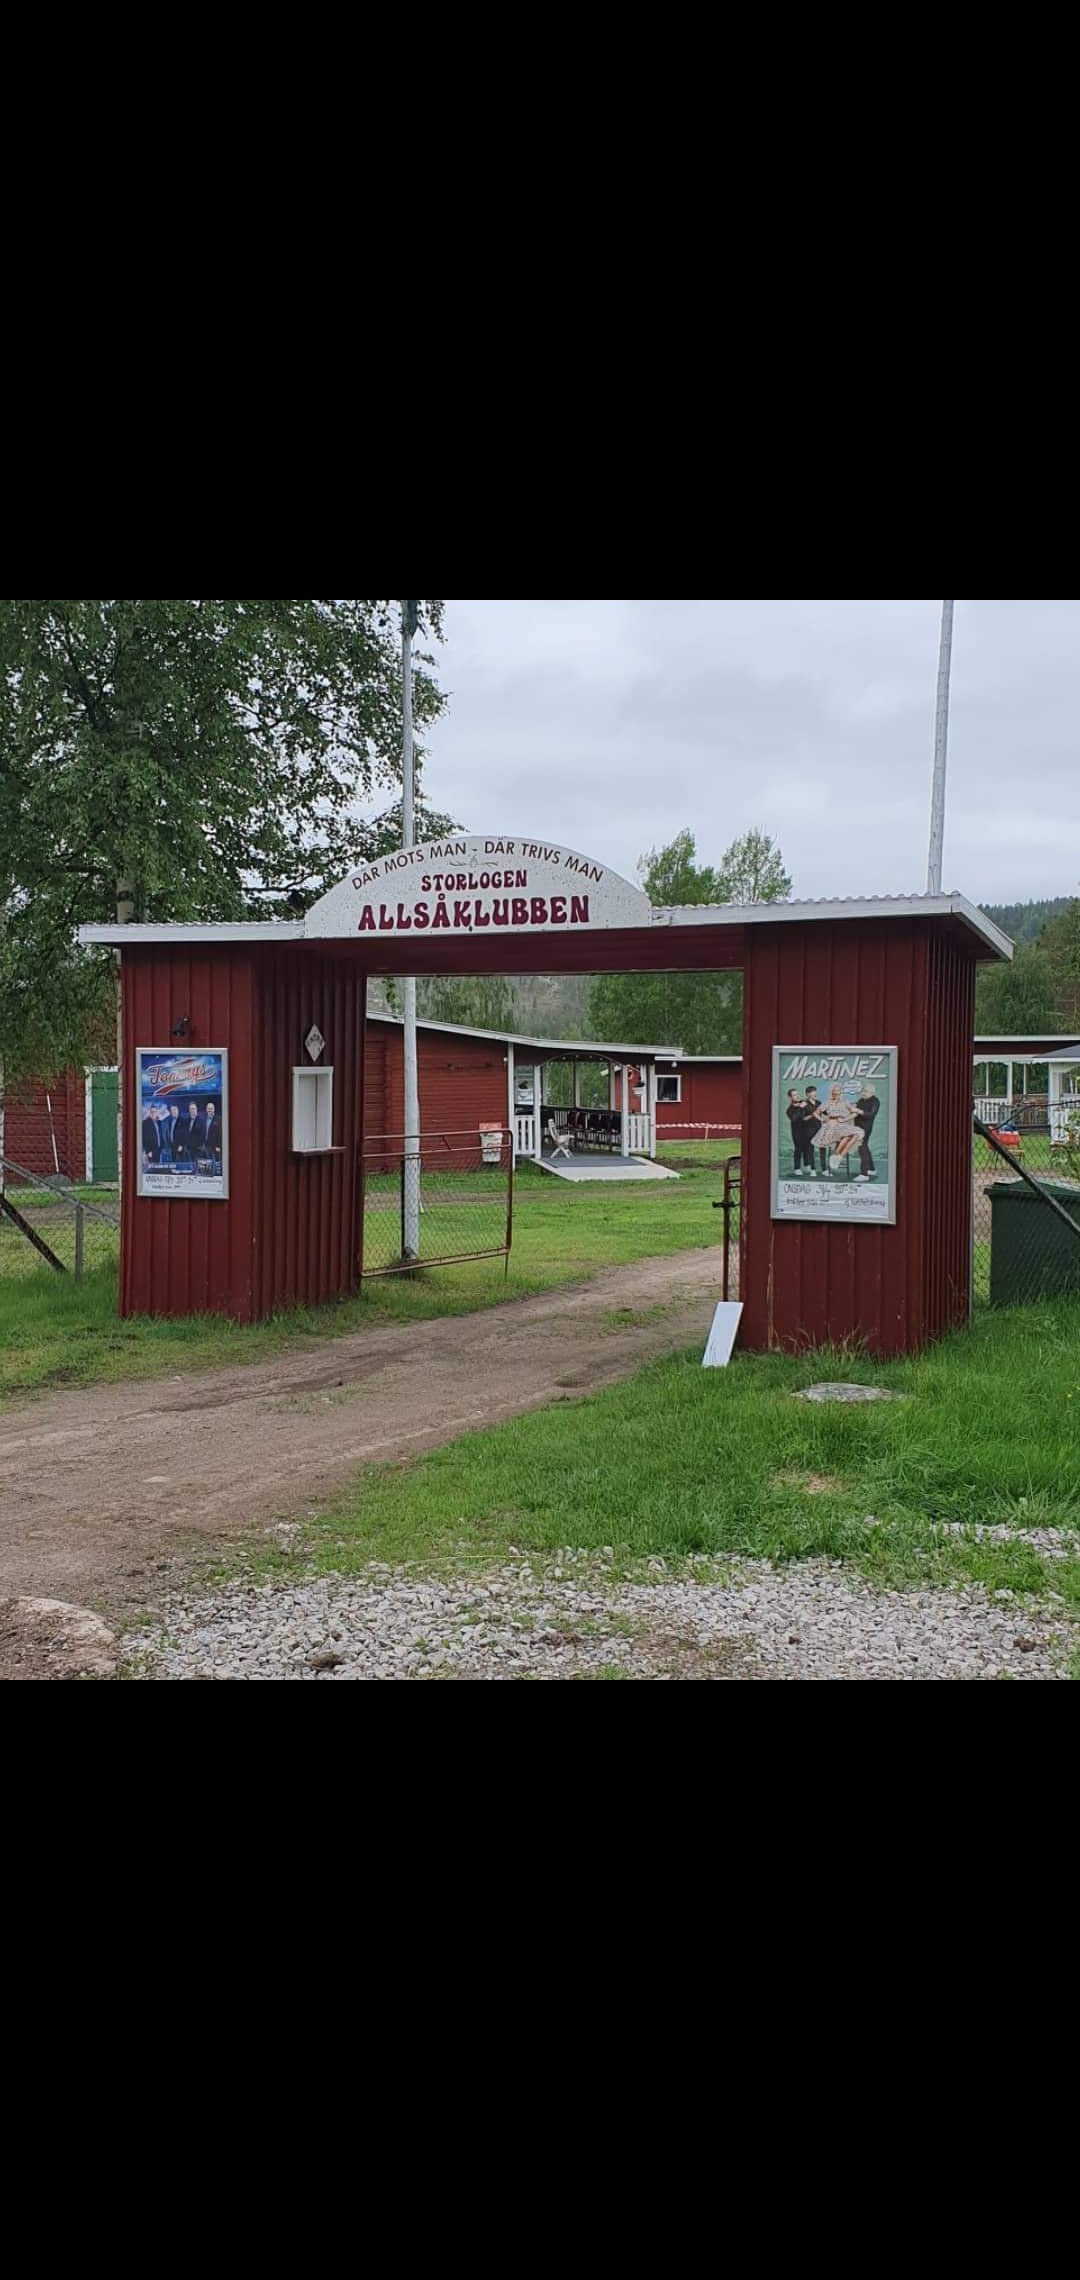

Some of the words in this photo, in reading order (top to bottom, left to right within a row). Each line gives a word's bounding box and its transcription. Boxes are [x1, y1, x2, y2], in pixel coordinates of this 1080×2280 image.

[430, 842, 466, 859] MAN
[484, 837, 515, 855] DÄR
[521, 843, 561, 864] TRIVS
[564, 856, 603, 883] MAN
[421, 870, 528, 892] STORLOGEN
[357, 893, 590, 931] ALLSÅKLUBBEN
[783, 1055, 888, 1080] MARTINEZ
